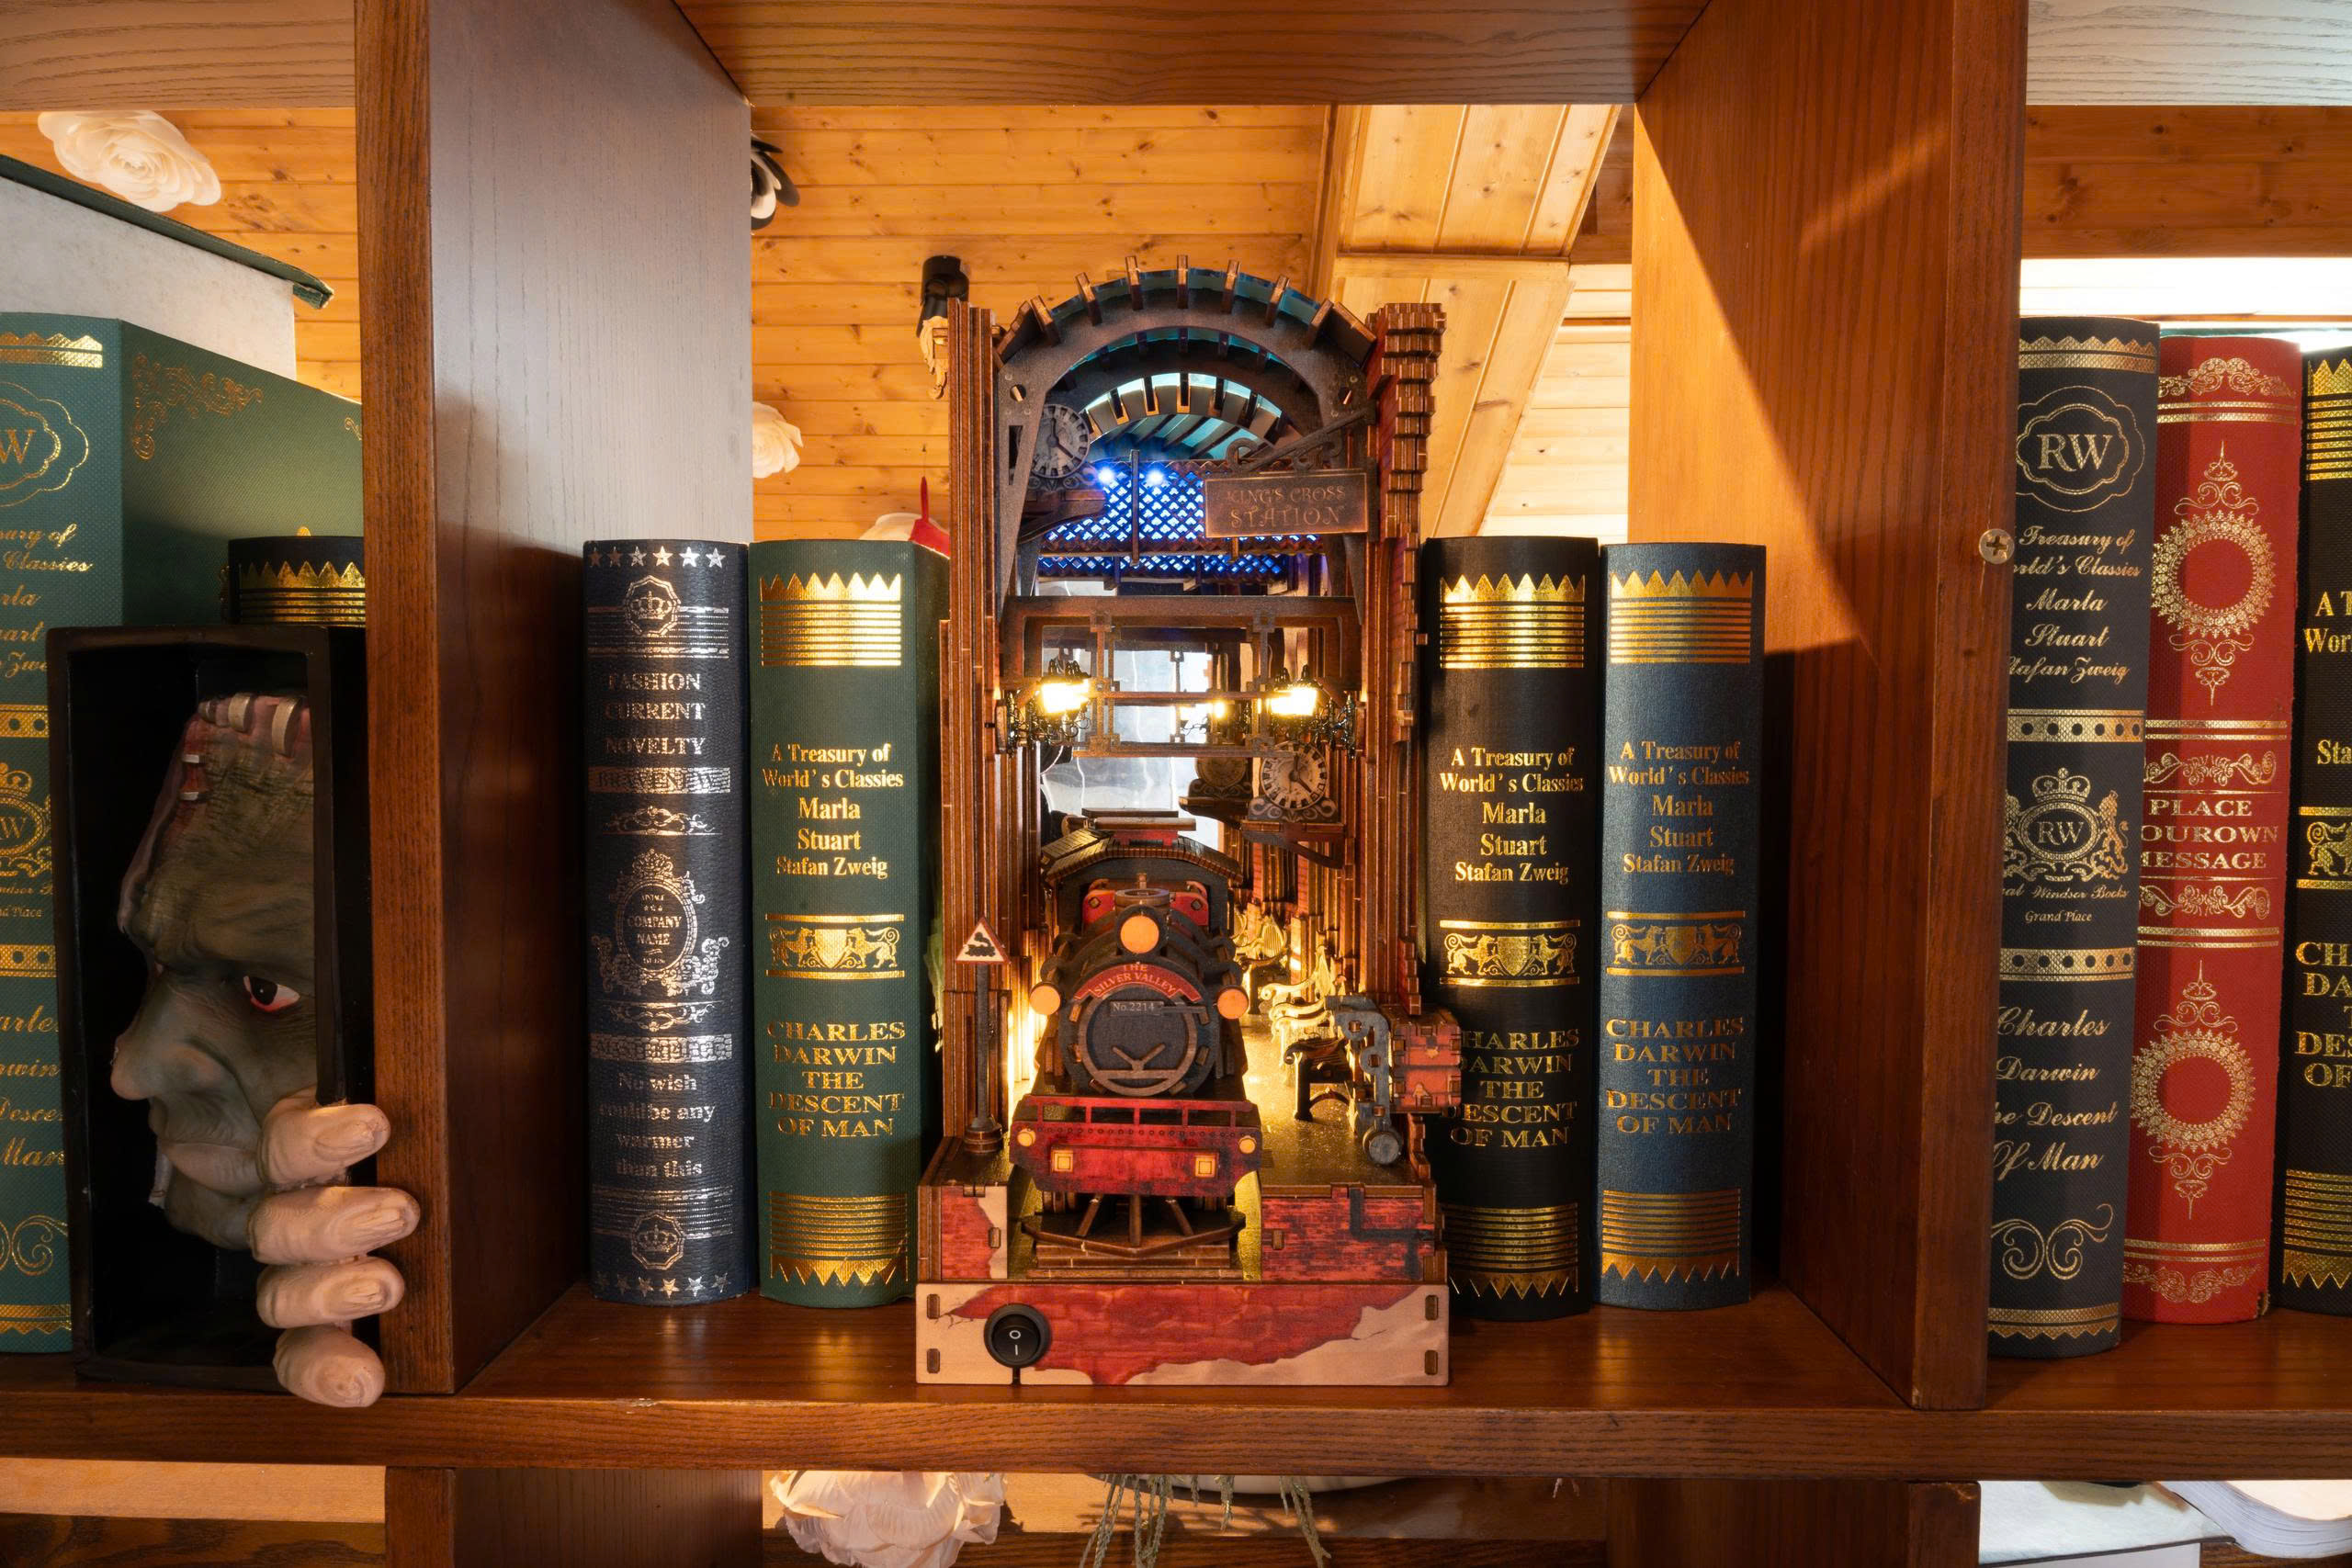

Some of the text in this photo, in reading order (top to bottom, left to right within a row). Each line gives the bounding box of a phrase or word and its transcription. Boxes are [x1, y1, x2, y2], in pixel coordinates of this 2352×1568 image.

[0, 428, 37, 464] W
[2037, 433, 2113, 473] RW
[1227, 485, 1346, 504] KING'S CROSS
[1230, 506, 1344, 528] STATION
[49, 524, 77, 548] of
[2018, 525, 2135, 554] Treasury of
[0, 584, 41, 606] rla
[2026, 588, 2108, 611] Marla
[2315, 592, 2335, 616] A
[2024, 624, 2109, 647] Stuart
[6, 651, 47, 678] Zwe
[2071, 656, 2130, 684] Zweig
[608, 672, 701, 691] FASHION
[604, 702, 706, 720] CURRENT
[603, 738, 706, 755] NOVELTY
[772, 743, 891, 767] A Treasury of
[1620, 741, 1741, 764] A Treasury of
[2317, 739, 2352, 764] Sta
[1451, 746, 1575, 771] A Treasury of
[835, 768, 904, 788] Classies
[1522, 773, 1583, 793] Classies
[1691, 766, 1749, 785] Classies
[798, 797, 861, 819] Marla
[1482, 802, 1546, 825] Marla
[1652, 795, 1713, 817] Marla
[2149, 799, 2252, 817] PLACE
[797, 828, 861, 851] Stuart
[1649, 826, 1713, 848] Stuart
[2038, 821, 2084, 845] RW
[1480, 833, 1547, 856] Stuart
[776, 856, 888, 879] Stafan Zweig
[1455, 862, 1569, 886] Stafan Zweig
[1623, 854, 1735, 876] Stafan Zweig
[2032, 884, 2087, 898] Windsor
[2091, 884, 2129, 899] Books
[627, 916, 683, 928] COMPANY
[2025, 909, 2092, 923] Grand Place
[637, 933, 671, 945] NAME
[1094, 973, 1177, 994] SILVER VALLEY
[0, 1005, 58, 1032] arle
[1606, 1017, 1744, 1038] CHARLES
[1998, 1006, 2110, 1036] Charles
[766, 1021, 907, 1042] CHARLES
[1462, 1029, 1579, 1051] HARLES
[774, 1044, 897, 1066] DARWIN
[1614, 1043, 1736, 1062] DARWIN
[0, 1059, 60, 1077] rwin
[1460, 1055, 1572, 1075] ARWIN
[1996, 1056, 2100, 1081] Darwin
[650, 1075, 696, 1091] wish
[802, 1071, 864, 1089] THE
[1648, 1068, 1709, 1087] THE
[1480, 1080, 1544, 1099] THE
[1606, 1089, 1741, 1110] DESCENT
[647, 1103, 671, 1120] be
[677, 1106, 716, 1122] any
[769, 1091, 905, 1114] DESCENT
[1995, 1100, 2119, 1126] he Descent
[777, 1116, 894, 1138] OF MAN
[1616, 1114, 1732, 1134] OF MAN
[616, 1134, 695, 1148] warmer
[1451, 1126, 1569, 1147] OF MAN
[663, 1160, 702, 1178] this
[1994, 1140, 2104, 1180] Of Man
